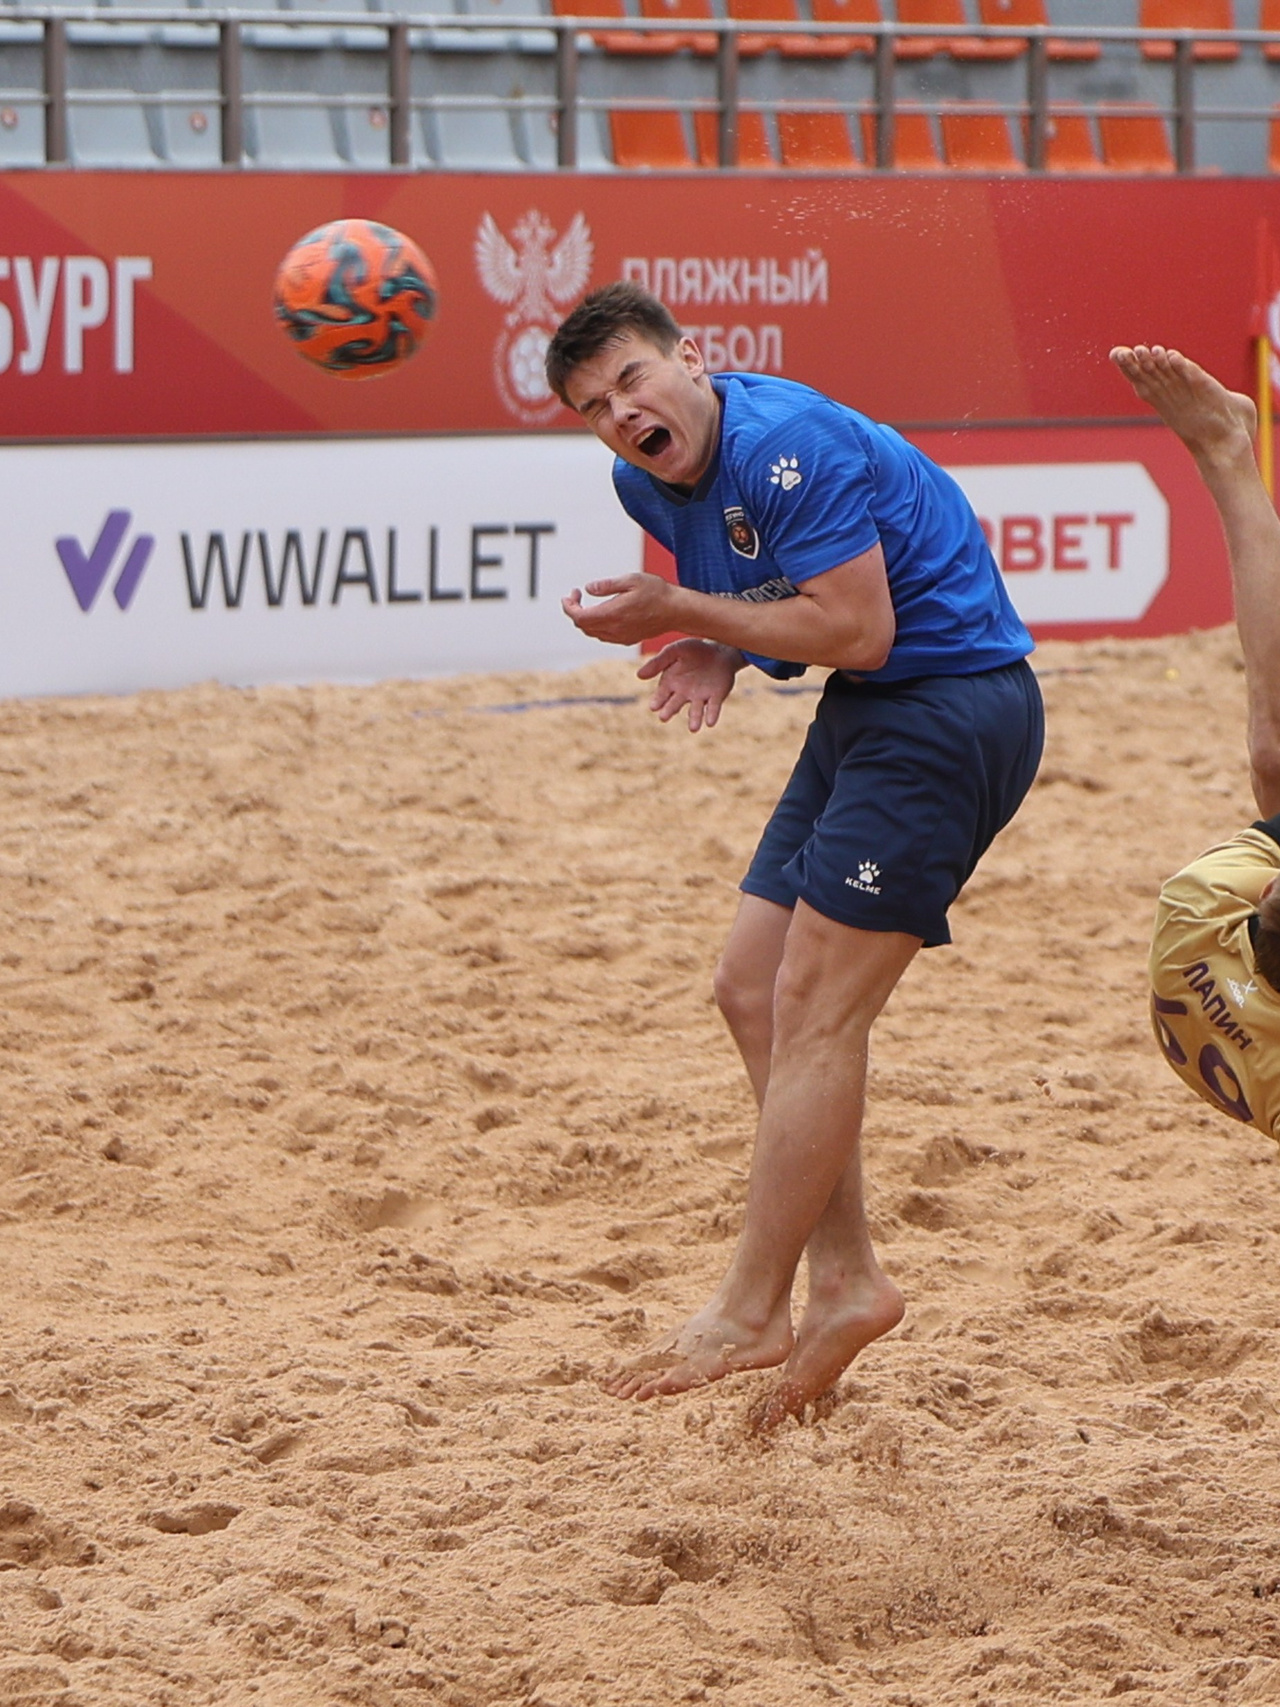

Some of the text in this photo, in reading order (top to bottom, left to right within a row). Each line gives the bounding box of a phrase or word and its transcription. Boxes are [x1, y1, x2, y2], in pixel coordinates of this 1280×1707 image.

[180, 522, 557, 610] WWALLET
[845, 876, 882, 895] KELME
[1183, 961, 1253, 1051] ЛАПИН
